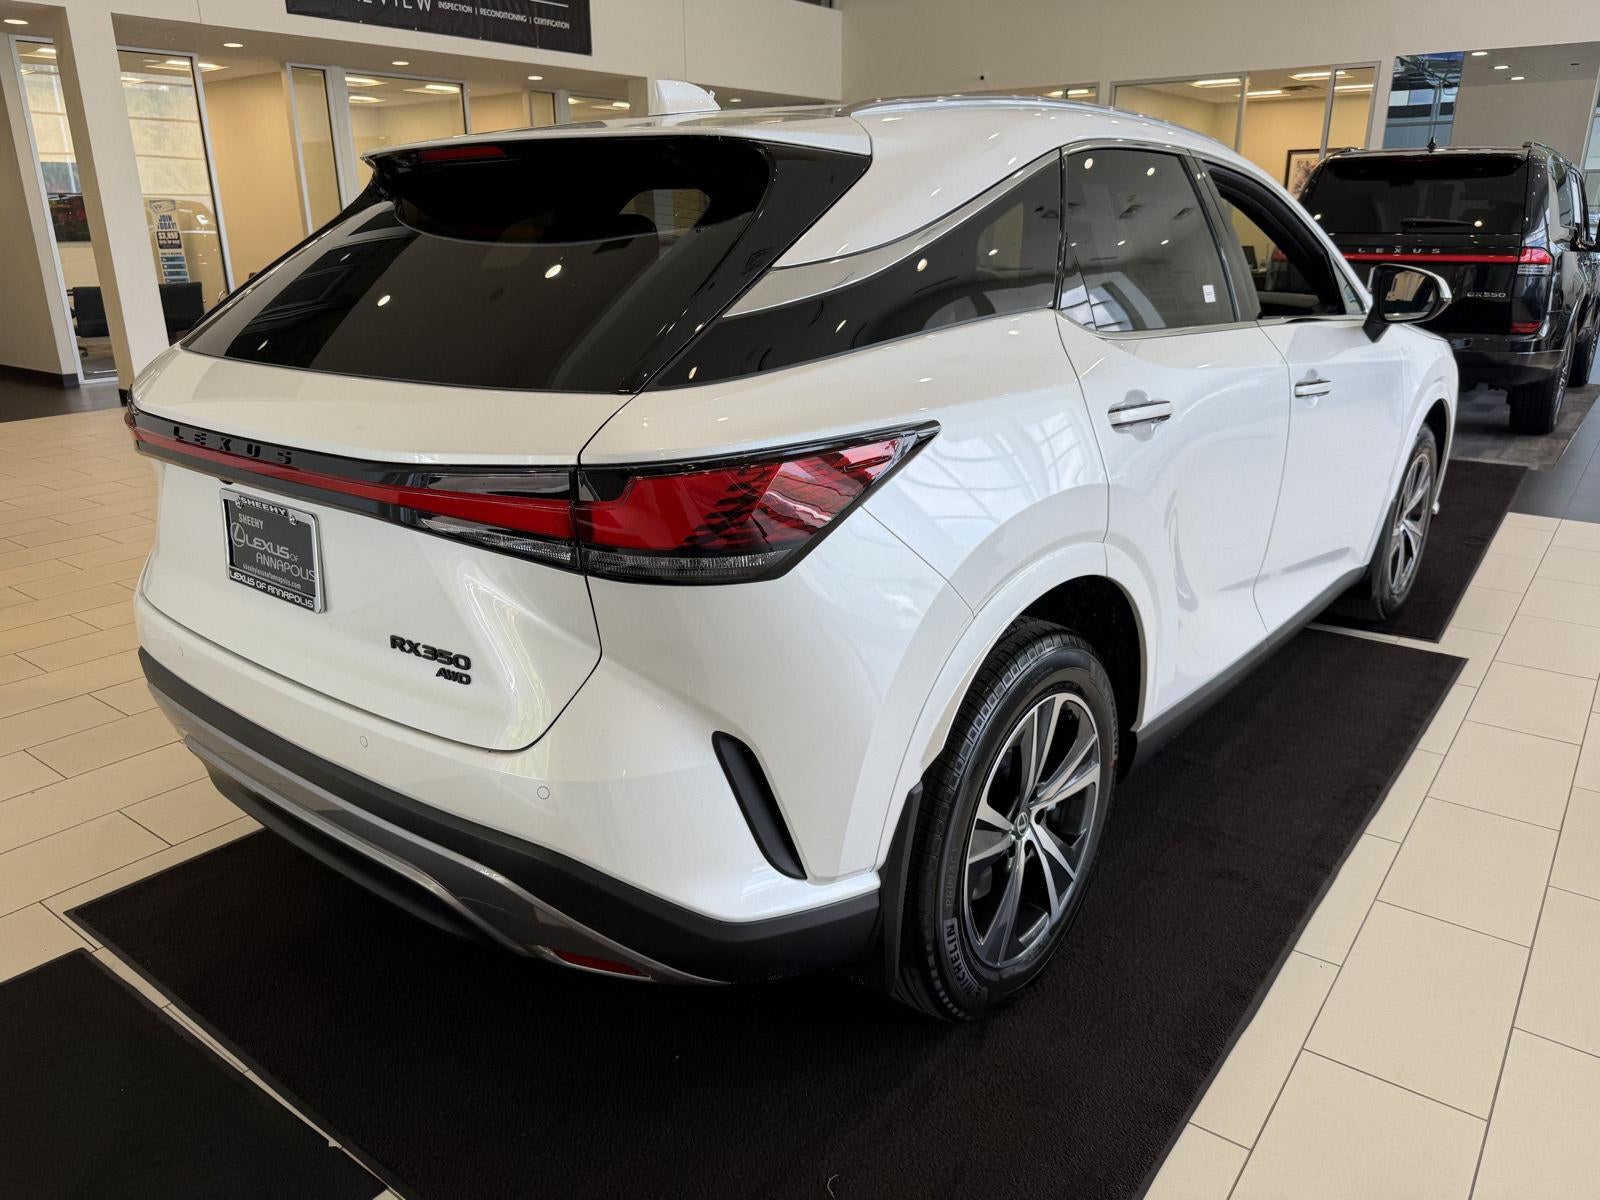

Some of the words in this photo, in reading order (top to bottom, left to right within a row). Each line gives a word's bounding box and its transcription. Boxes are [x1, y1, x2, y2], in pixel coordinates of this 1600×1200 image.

[438, 1, 473, 14] INSPECTION
[479, 8, 527, 23] RECONDITIONING
[533, 17, 570, 30] CERTIFICATION
[1357, 246, 1441, 254] LEXUS
[173, 426, 292, 465] LEXUS
[240, 496, 286, 515] SHEEHY
[238, 513, 264, 530] SHEEHY
[245, 534, 290, 560] LEXUS
[256, 552, 316, 582] ANNAPOLIS
[229, 570, 256, 586] LEXUS
[255, 581, 267, 590] OF
[267, 585, 314, 609] ANNAPOLIS
[389, 634, 472, 671] RX350
[435, 667, 472, 686] AWD
[945, 922, 976, 995] MICHELIN
